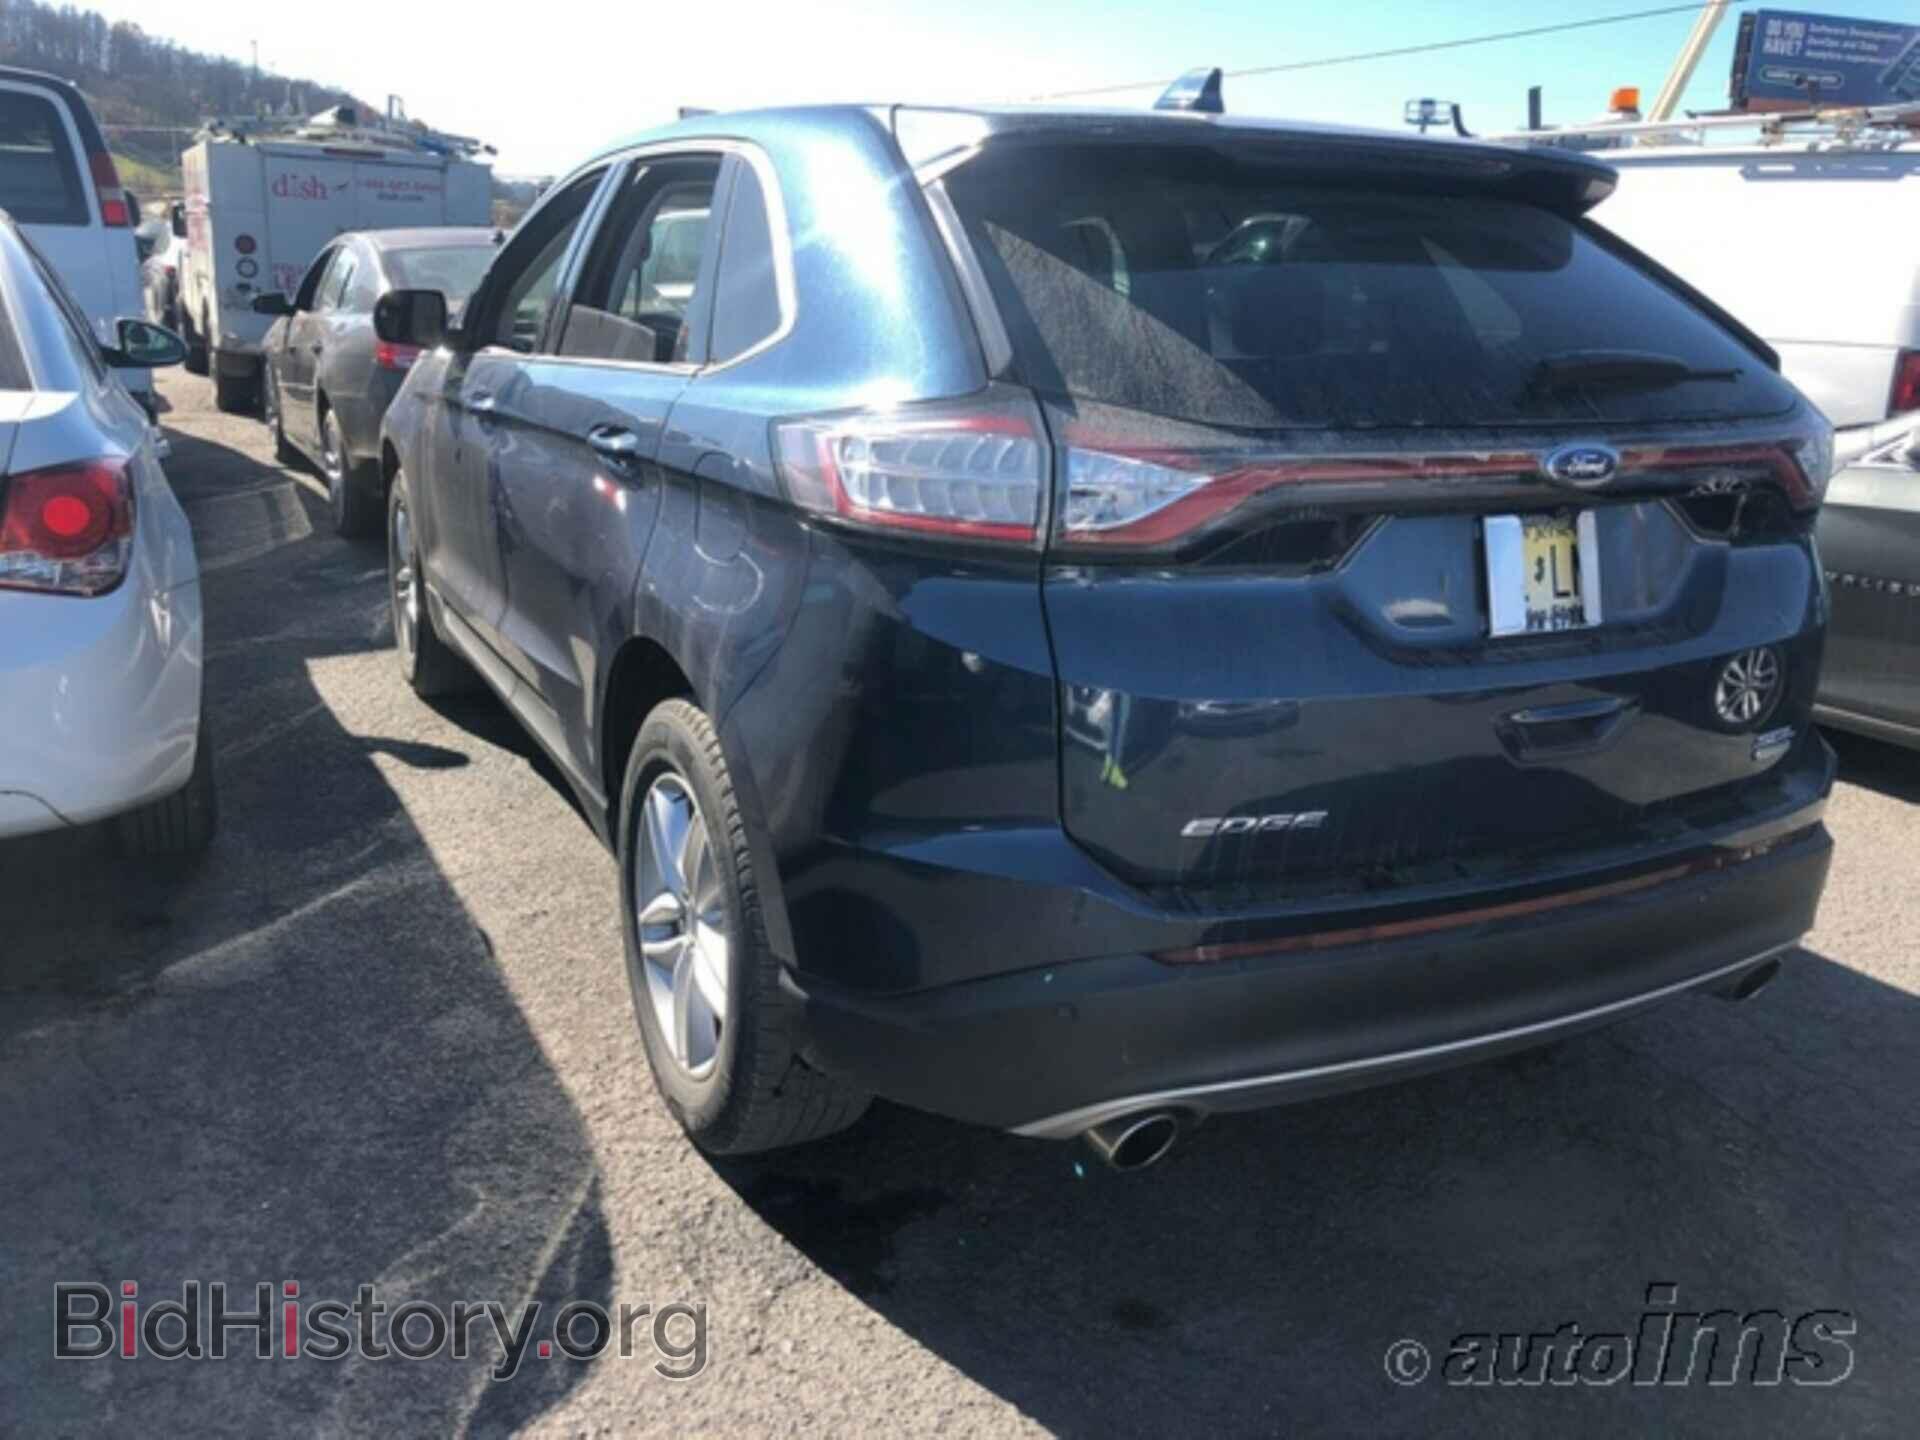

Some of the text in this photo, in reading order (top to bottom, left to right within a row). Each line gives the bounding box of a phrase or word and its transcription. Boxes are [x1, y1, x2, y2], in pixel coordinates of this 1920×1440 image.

[272, 173, 328, 200] dish
[1567, 453, 1607, 476] Ford
[1180, 810, 1329, 837] EDGE
